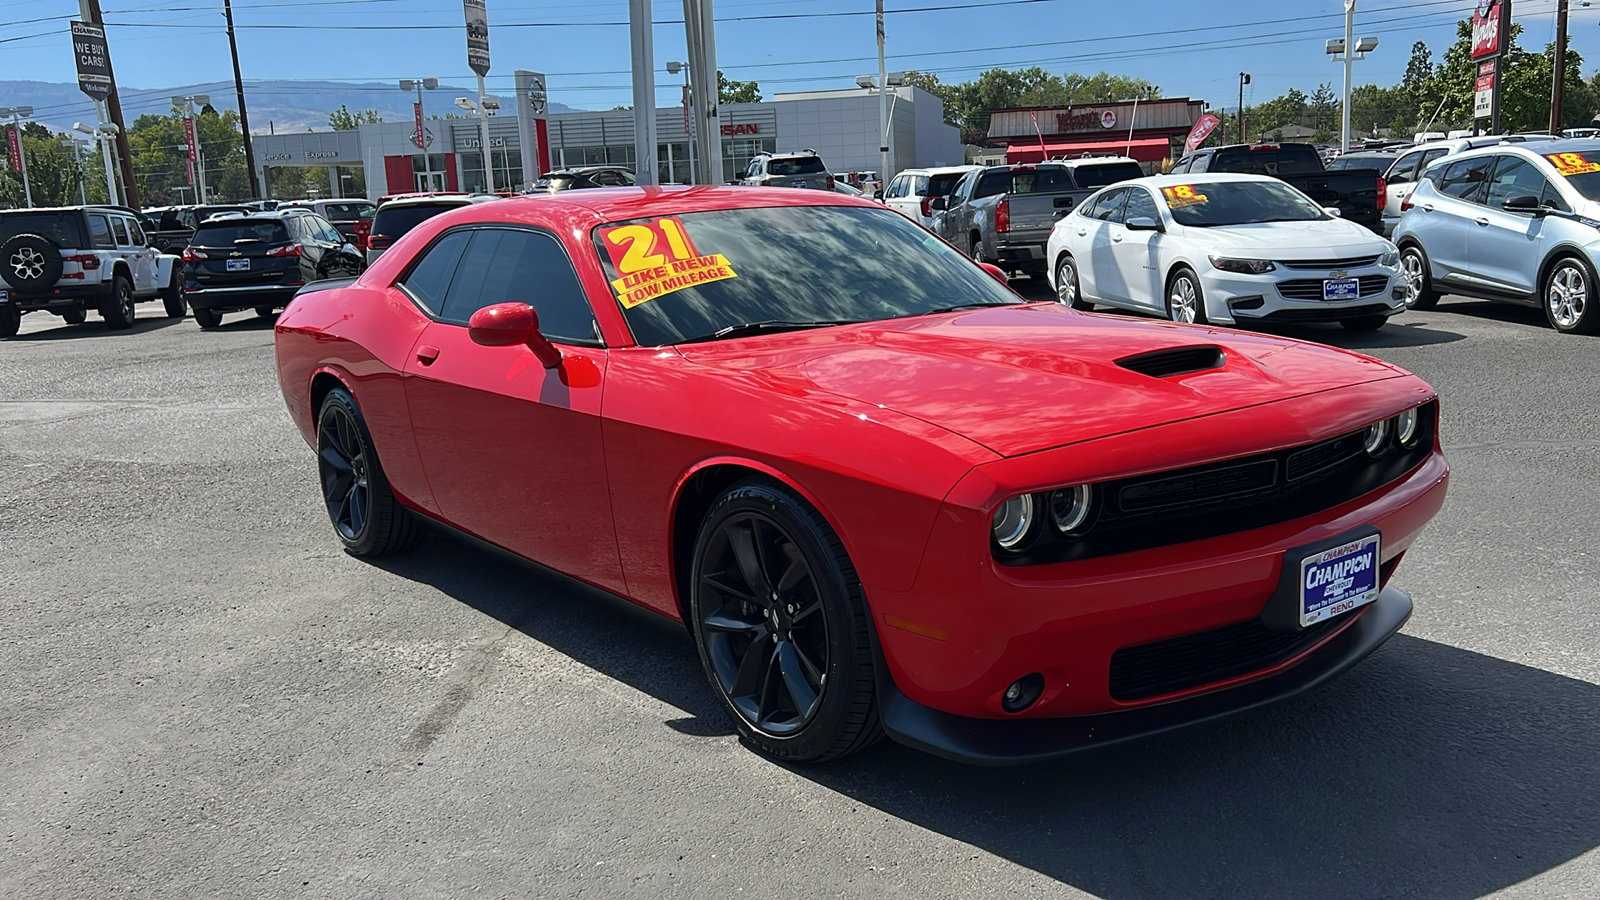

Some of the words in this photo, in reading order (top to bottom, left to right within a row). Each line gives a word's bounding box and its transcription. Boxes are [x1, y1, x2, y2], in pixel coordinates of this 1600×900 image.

[1472, 11, 1499, 54] Wendy's
[75, 43, 90, 54] WE
[91, 44, 104, 55] BUY
[81, 55, 105, 67] CARS!
[720, 123, 757, 136] SAN
[187, 130, 196, 160] NISSAN
[463, 136, 503, 148] Unied
[261, 153, 291, 161] Service
[305, 151, 338, 160] Express
[1549, 153, 1583, 168] 18
[1165, 186, 1193, 201] 18
[607, 219, 694, 274] 21
[623, 265, 669, 289] LIKE
[673, 255, 718, 274] NEW
[627, 284, 661, 304] LOW
[663, 267, 729, 291] MILEAGE
[1323, 542, 1360, 561] CHAMPION
[1306, 552, 1372, 589] CHAMPION
[1326, 579, 1352, 593] CHEVROLET
[1330, 600, 1354, 615] RENO
